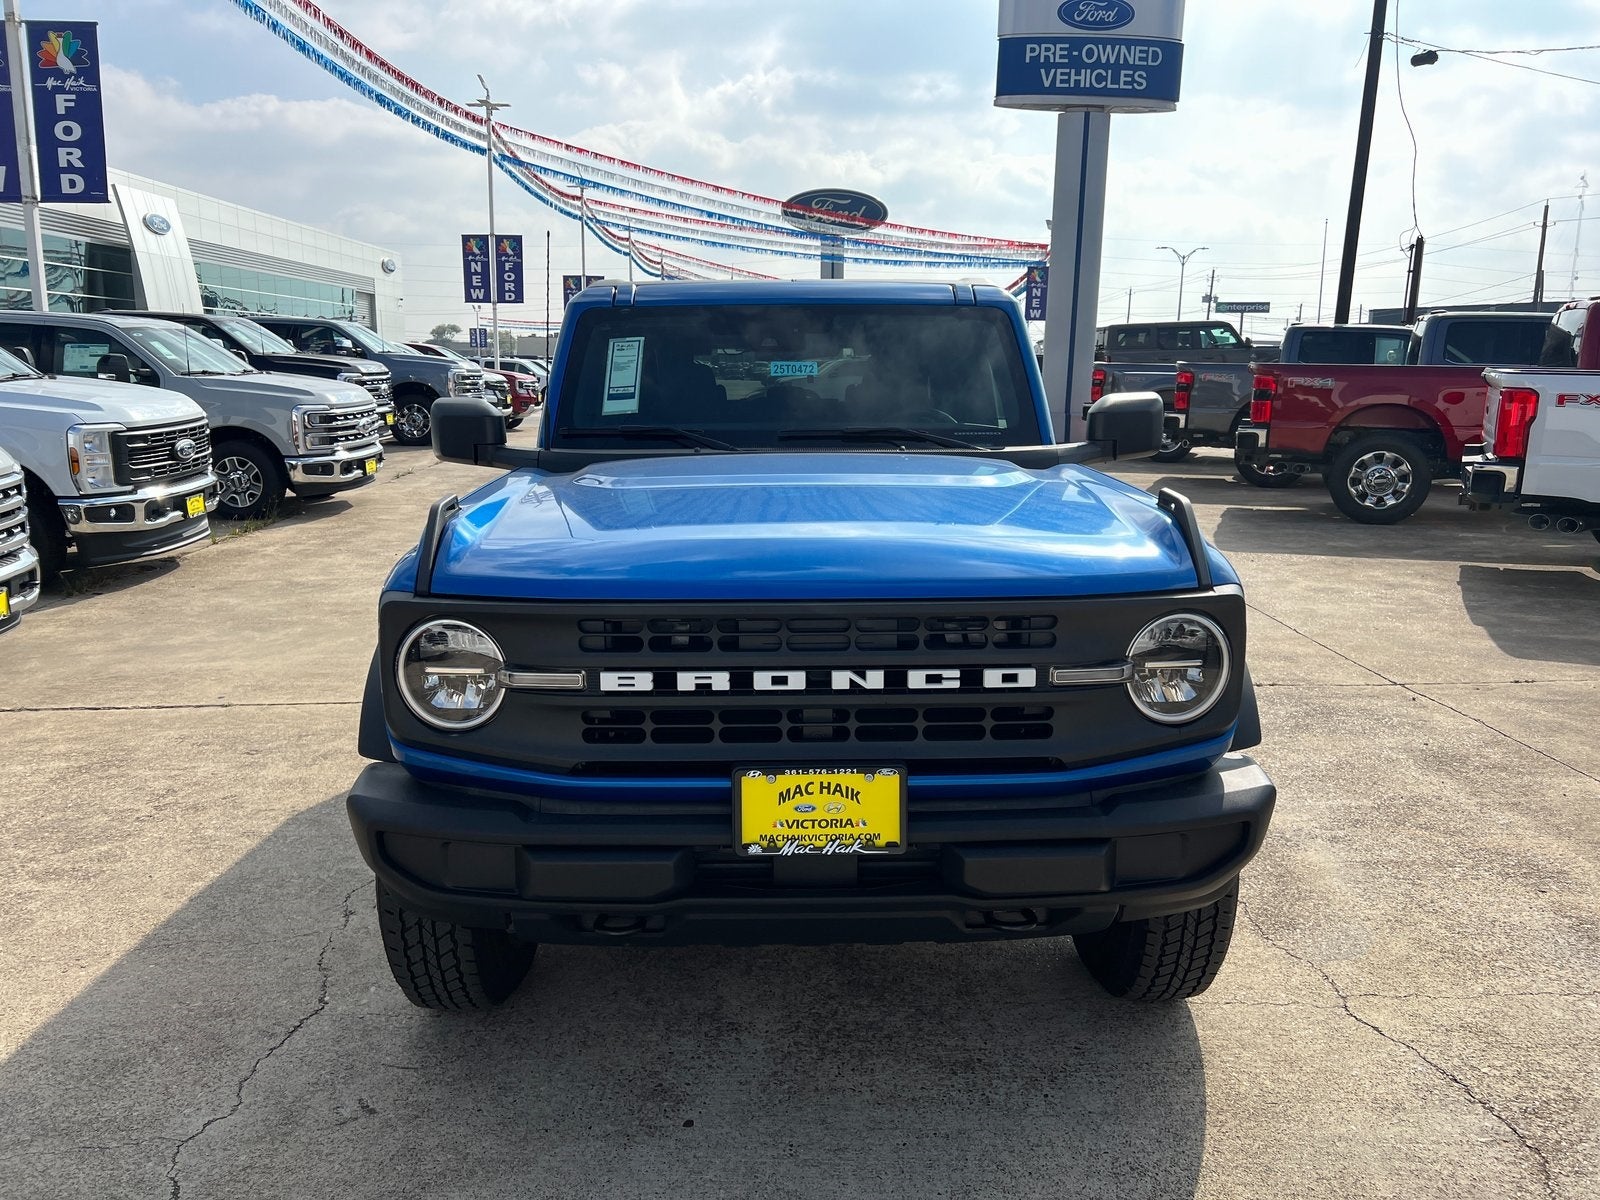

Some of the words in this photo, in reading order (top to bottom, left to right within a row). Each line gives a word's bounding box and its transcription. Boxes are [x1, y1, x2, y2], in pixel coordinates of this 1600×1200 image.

[1074, 0, 1118, 22] Ford
[1025, 43, 1162, 66] PRE-OWNED
[45, 76, 62, 90] Mac
[64, 75, 86, 91] Haik
[1040, 68, 1147, 90] VEHICLES
[54, 94, 85, 194] FORD
[805, 197, 867, 224] Fd
[470, 262, 485, 300] NEW
[504, 262, 516, 301] FORD
[1029, 288, 1042, 318] NEW
[1217, 303, 1269, 312] enterprise
[773, 364, 815, 375] 25T0472
[1287, 376, 1335, 389] FX4
[599, 668, 1037, 692] BRONCO
[777, 781, 815, 806] MAC
[819, 781, 862, 805] HAIK
[784, 818, 855, 829] VICTORIA
[779, 840, 817, 856] Mac
[821, 839, 864, 856] Haik
